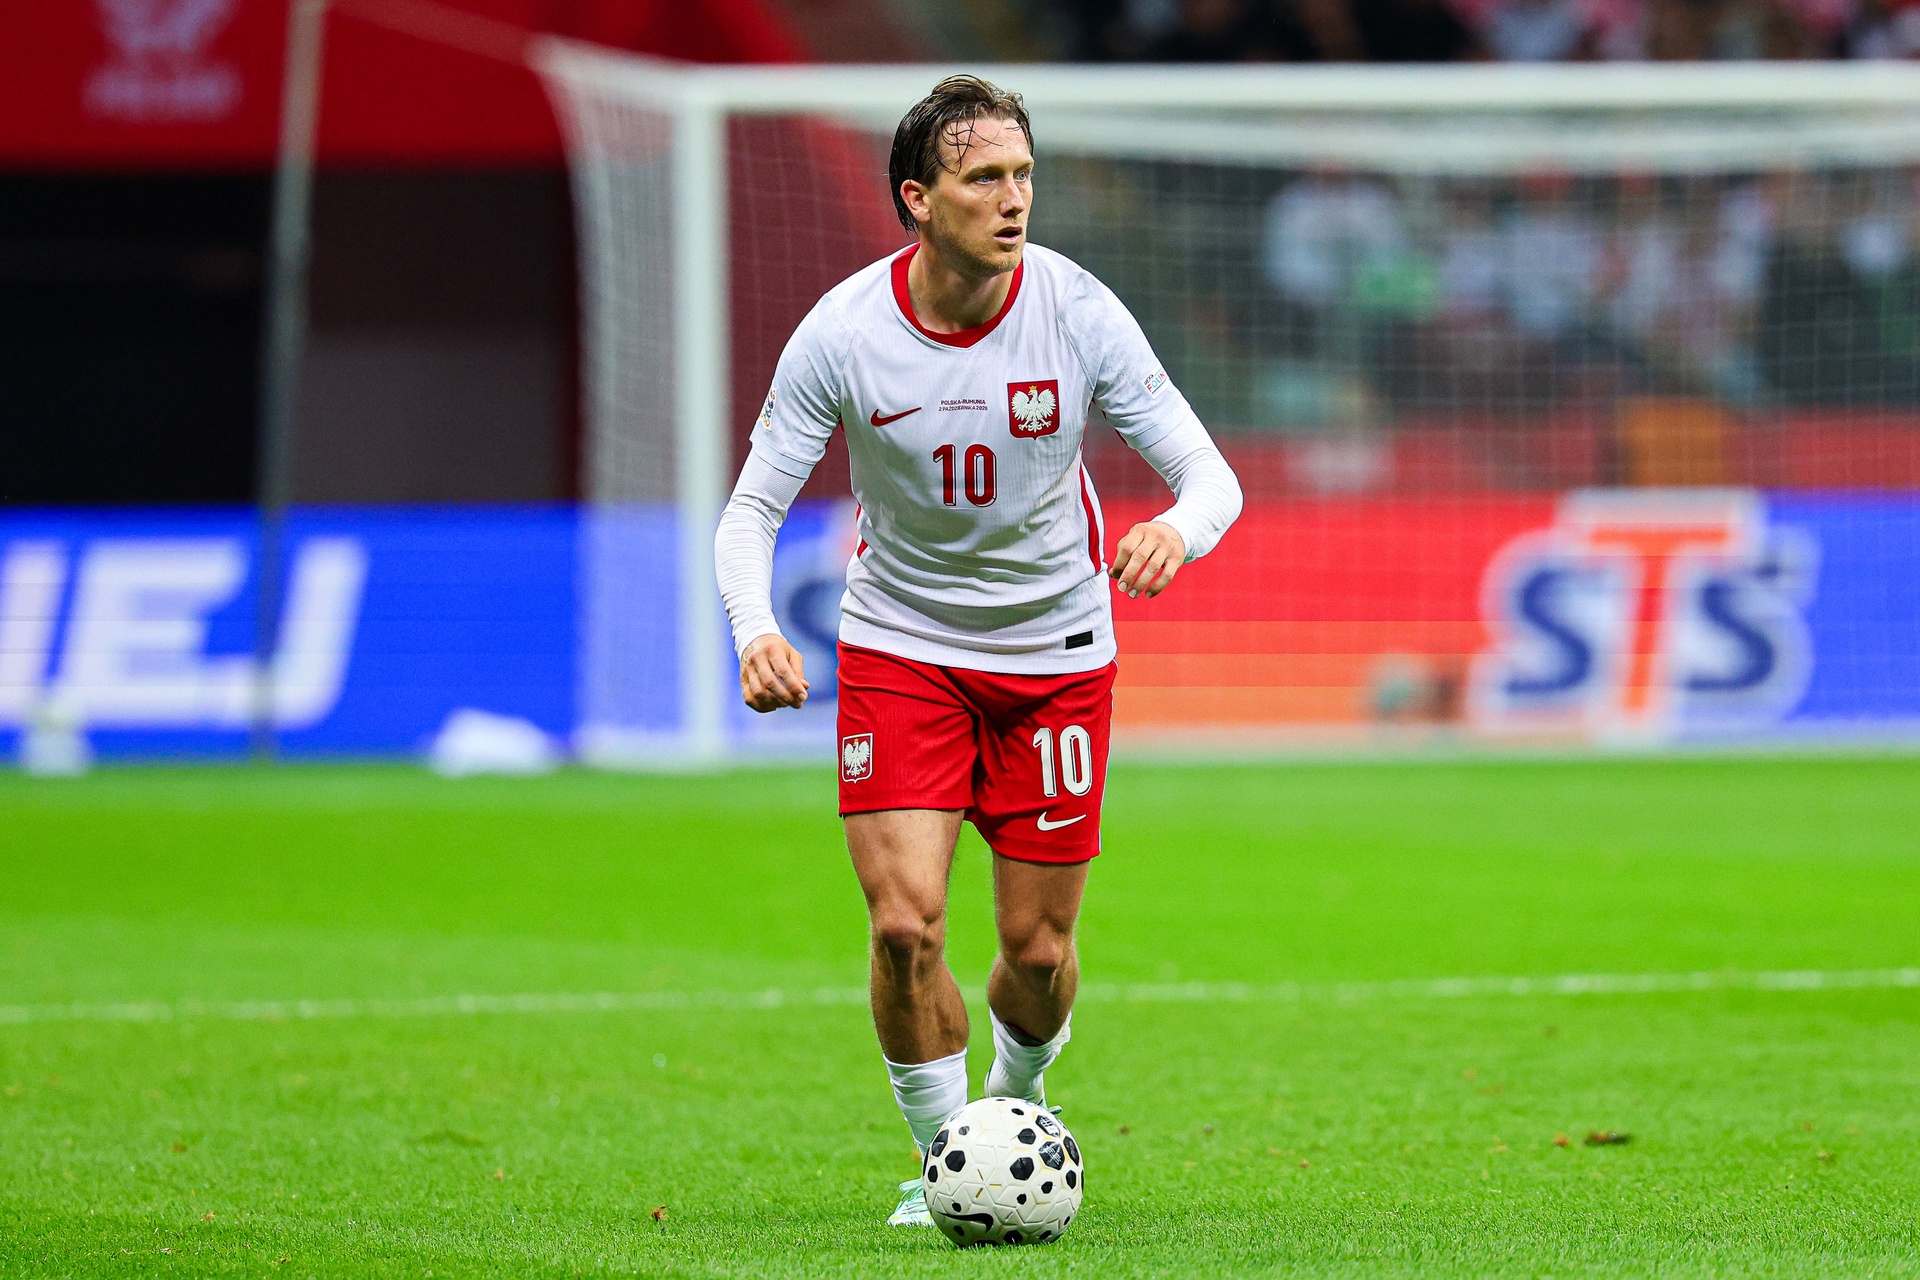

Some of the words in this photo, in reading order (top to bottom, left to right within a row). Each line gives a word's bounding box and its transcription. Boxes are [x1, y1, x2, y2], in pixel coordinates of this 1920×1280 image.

[933, 443, 998, 508] 10
[1500, 526, 1779, 716] STS
[1033, 725, 1093, 798] 10
